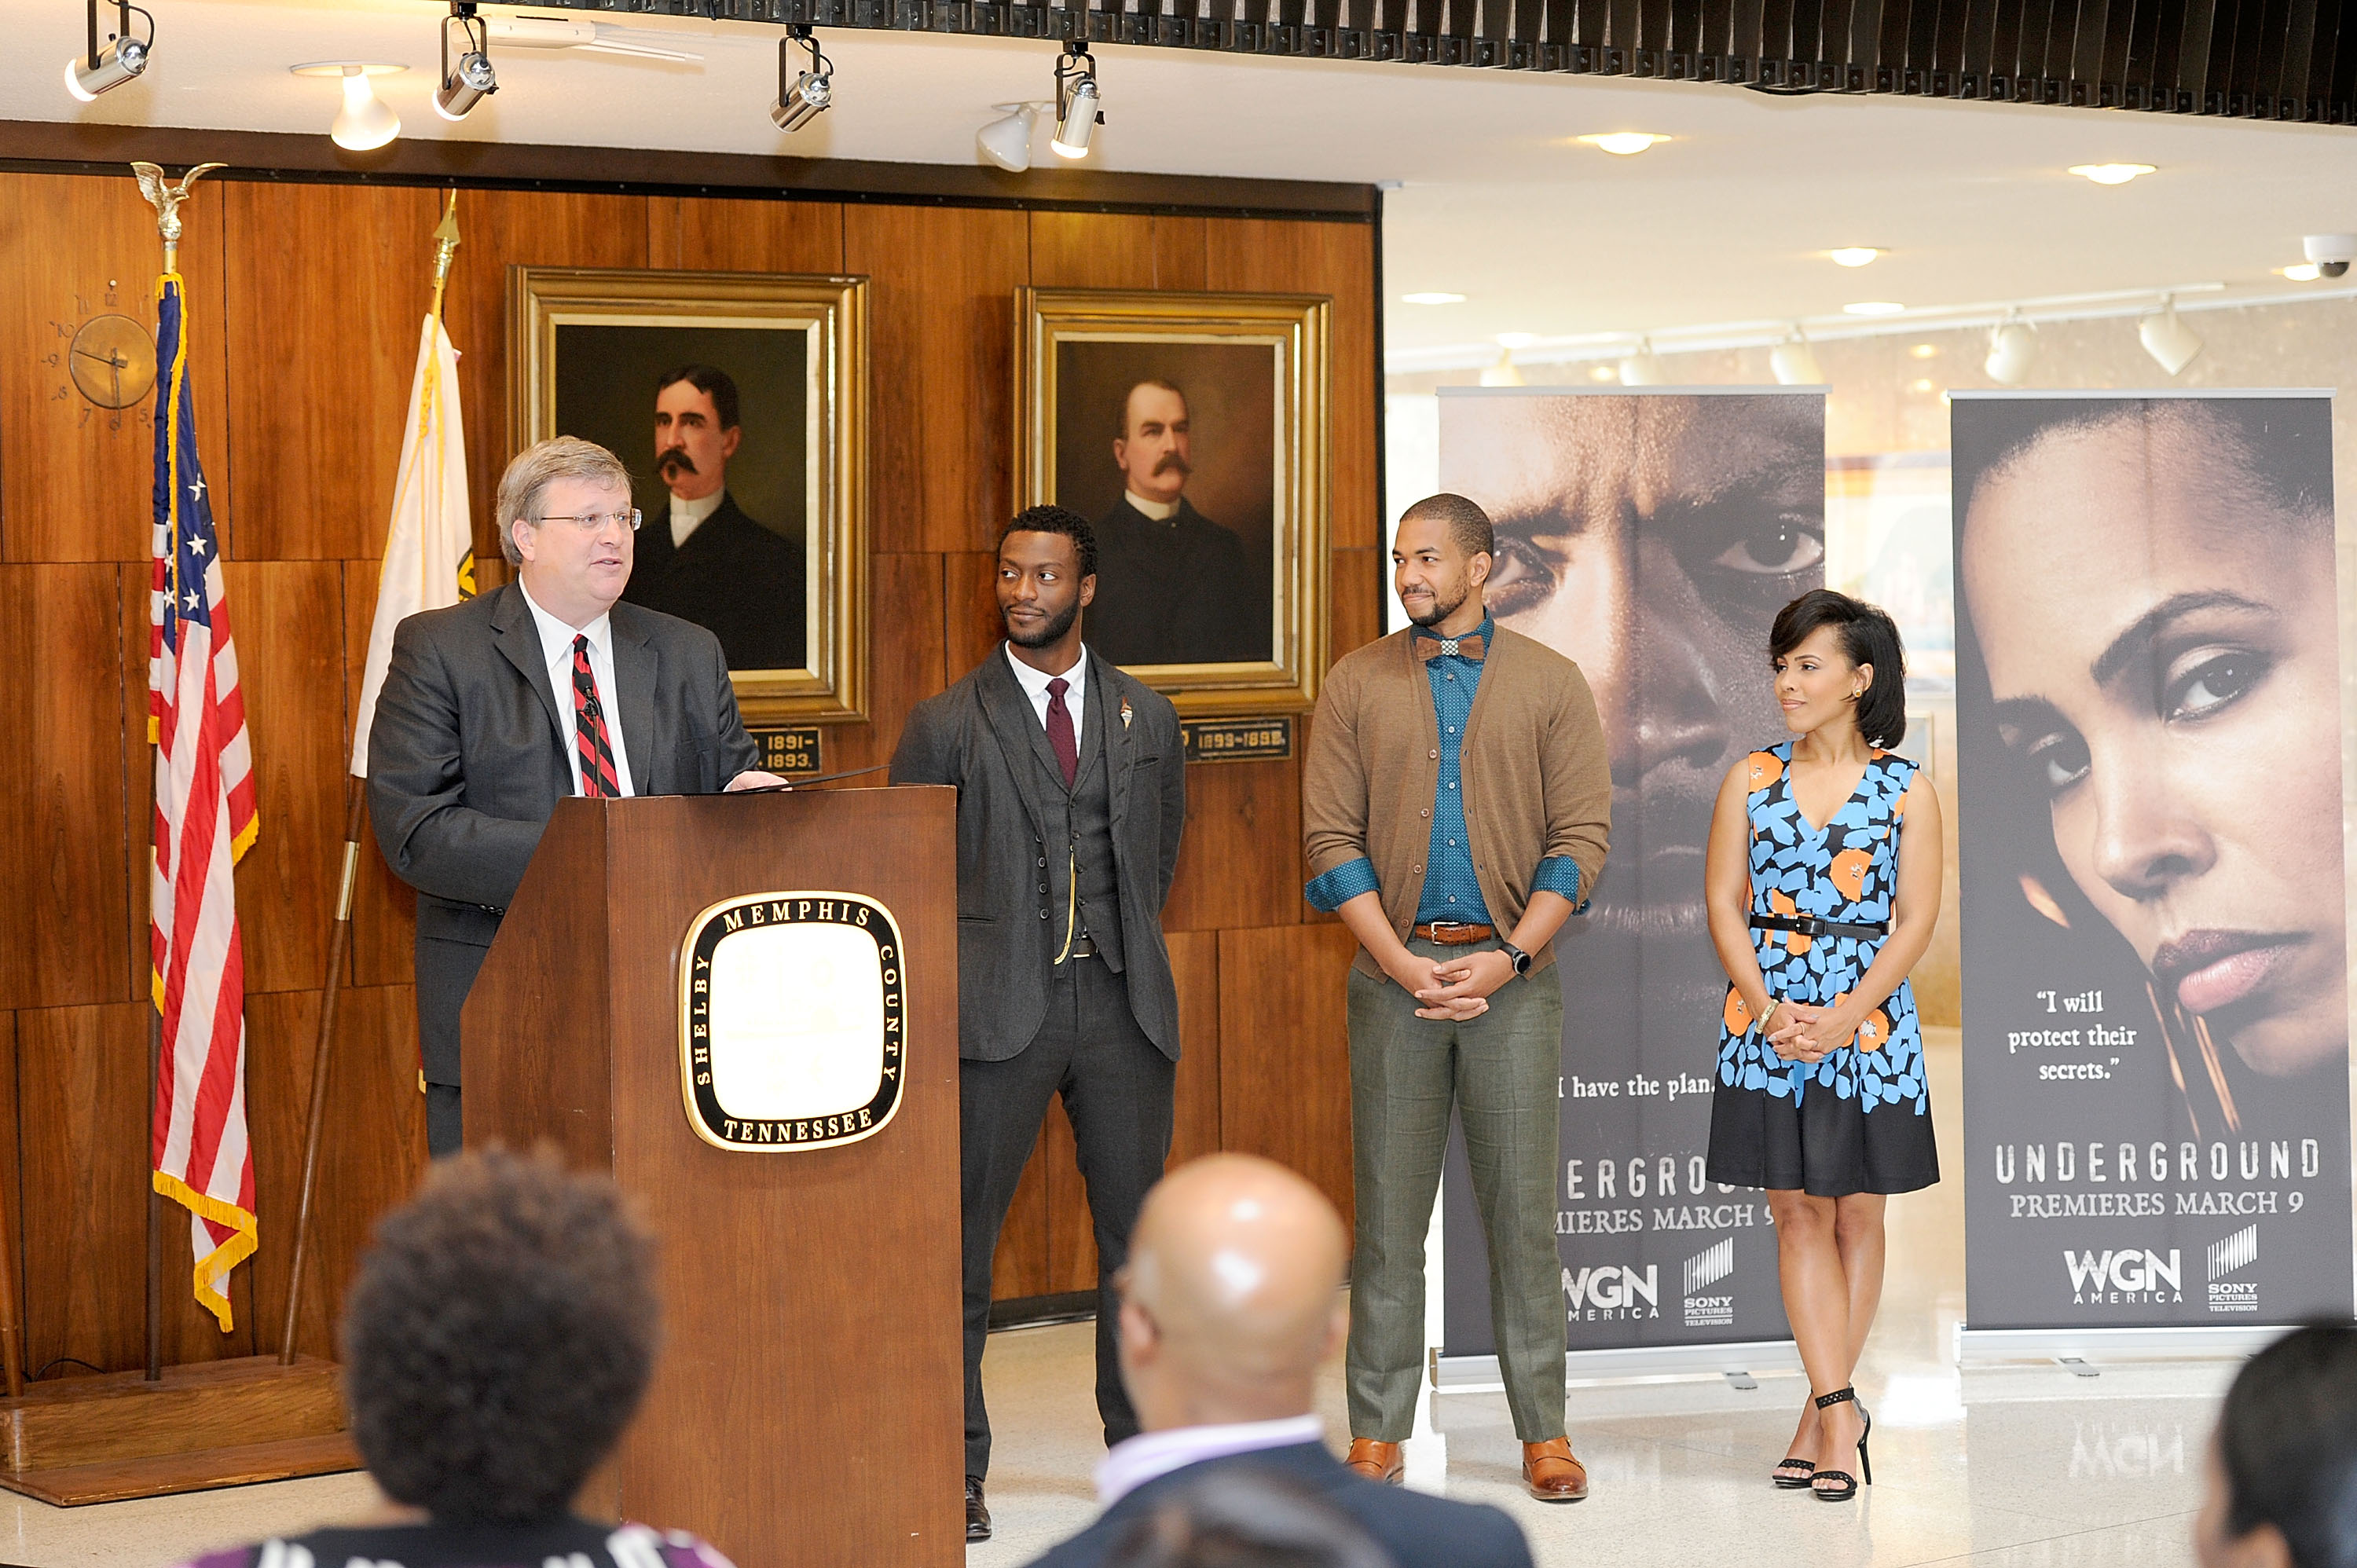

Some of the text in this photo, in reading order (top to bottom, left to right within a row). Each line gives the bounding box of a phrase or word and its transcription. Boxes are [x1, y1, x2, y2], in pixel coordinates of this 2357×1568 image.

[768, 735, 814, 750] 1891-
[767, 753, 812, 768] 1893.
[723, 900, 870, 932] MEMPHIS
[880, 945, 900, 1081] COUNTY
[2064, 991, 2103, 1012] will
[694, 956, 711, 1086] SHELBY
[2008, 1024, 2137, 1053] protect their
[2039, 1057, 2120, 1080] secrets.”
[1572, 1075, 1619, 1098] have
[1626, 1074, 1660, 1096] the
[1667, 1072, 1716, 1101] plan.
[724, 1108, 872, 1141] TENNESSEE
[1996, 1138, 2320, 1185] UNDERGROUND
[1567, 1156, 1766, 1200] ERGRO
[2009, 1191, 2304, 1218] PREMIERES MARCH 9
[1652, 1204, 1754, 1230] MARCH
[2064, 1249, 2180, 1292] WGN
[2073, 1290, 2183, 1304] AMERICA
[2208, 1283, 2258, 1294] SONY
[2209, 1293, 2258, 1302] PICTURES
[1684, 1296, 1733, 1308] SONY
[1684, 1307, 1733, 1316] PICTURES
[1567, 1308, 1659, 1322] MERICA
[1684, 1318, 1733, 1327] TELEVISION
